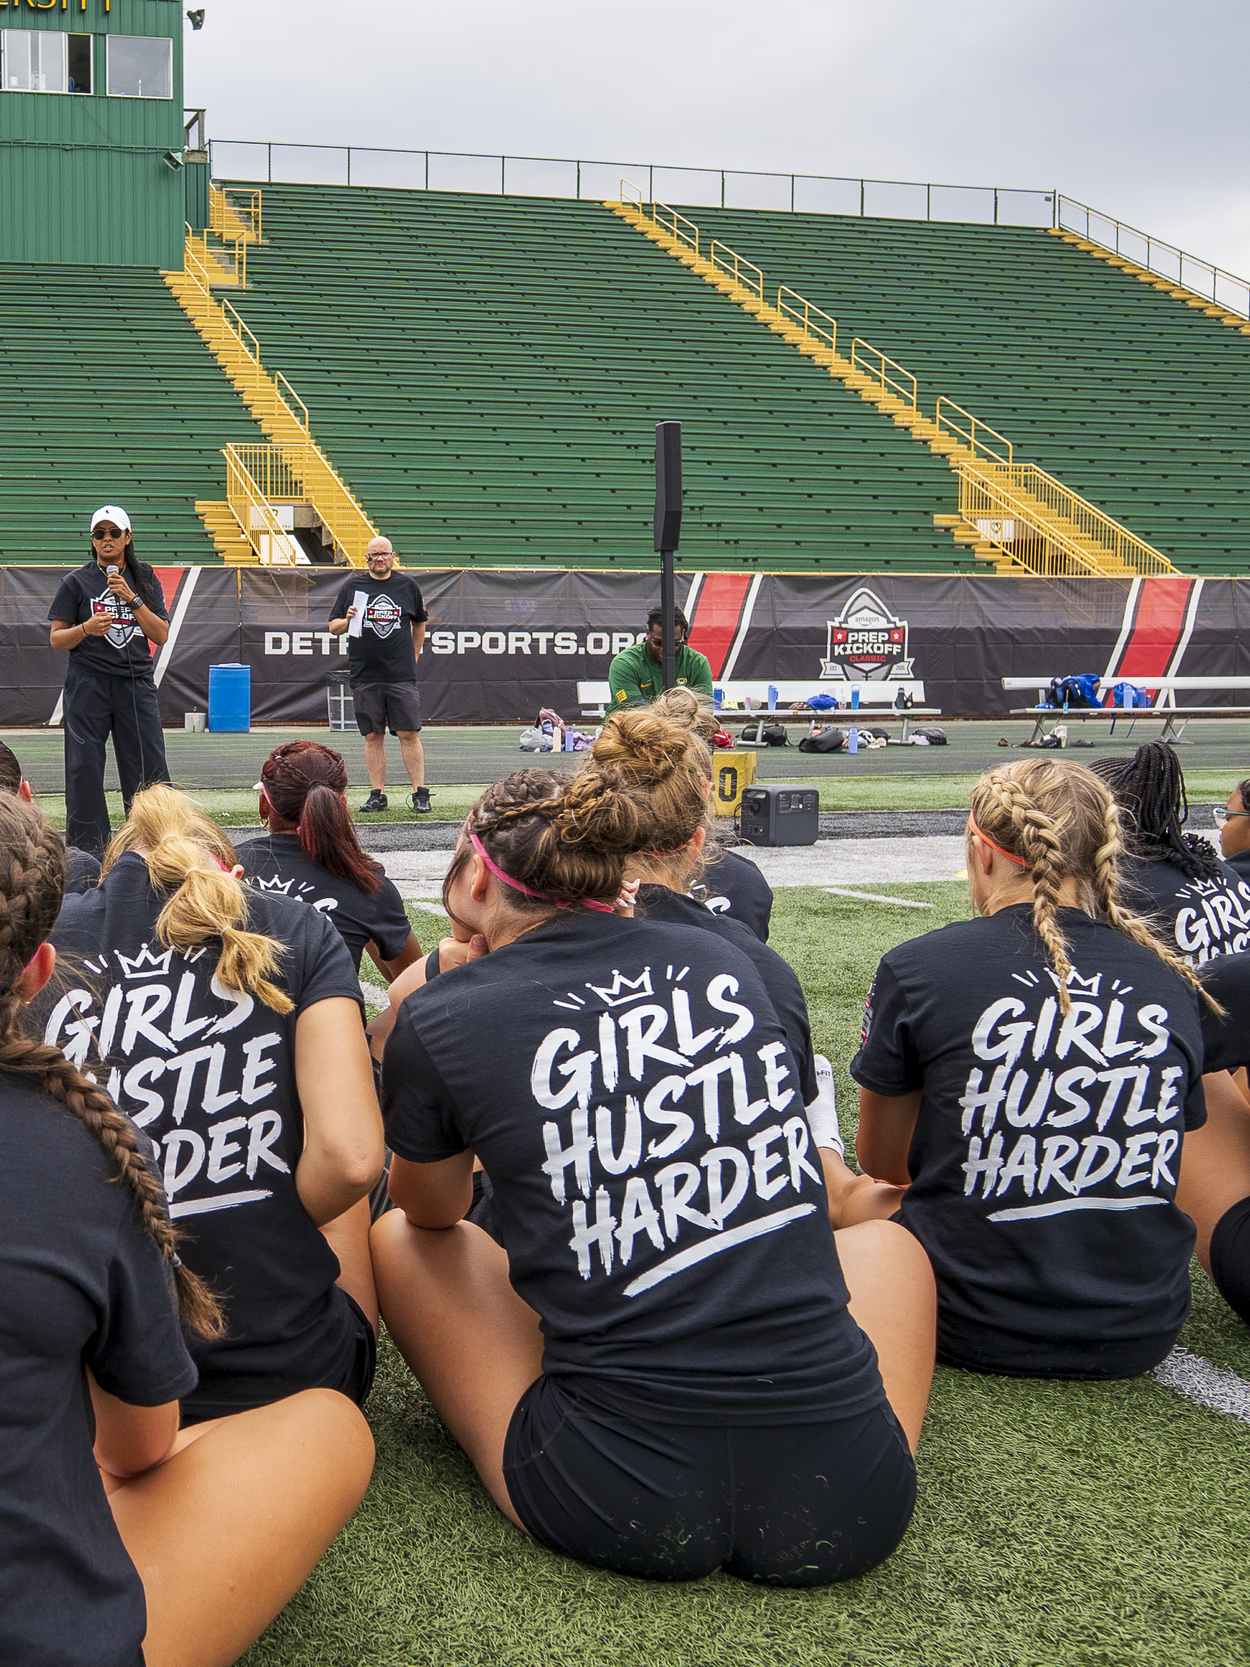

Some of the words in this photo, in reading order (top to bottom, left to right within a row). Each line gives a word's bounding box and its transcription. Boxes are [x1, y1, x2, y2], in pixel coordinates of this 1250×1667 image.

[264, 631, 647, 655] DETSPORTS.OR
[834, 643, 901, 656] KICKOFF
[848, 632, 889, 643] PREP
[530, 973, 754, 1110] GIRLS
[971, 996, 1171, 1068] GIRLS
[84, 1032, 282, 1127] STLE
[958, 1063, 1184, 1138] HUSTLE
[541, 1041, 795, 1206] HUSTLE
[569, 1116, 823, 1281] HARDER
[961, 1129, 1180, 1200] HARDER
